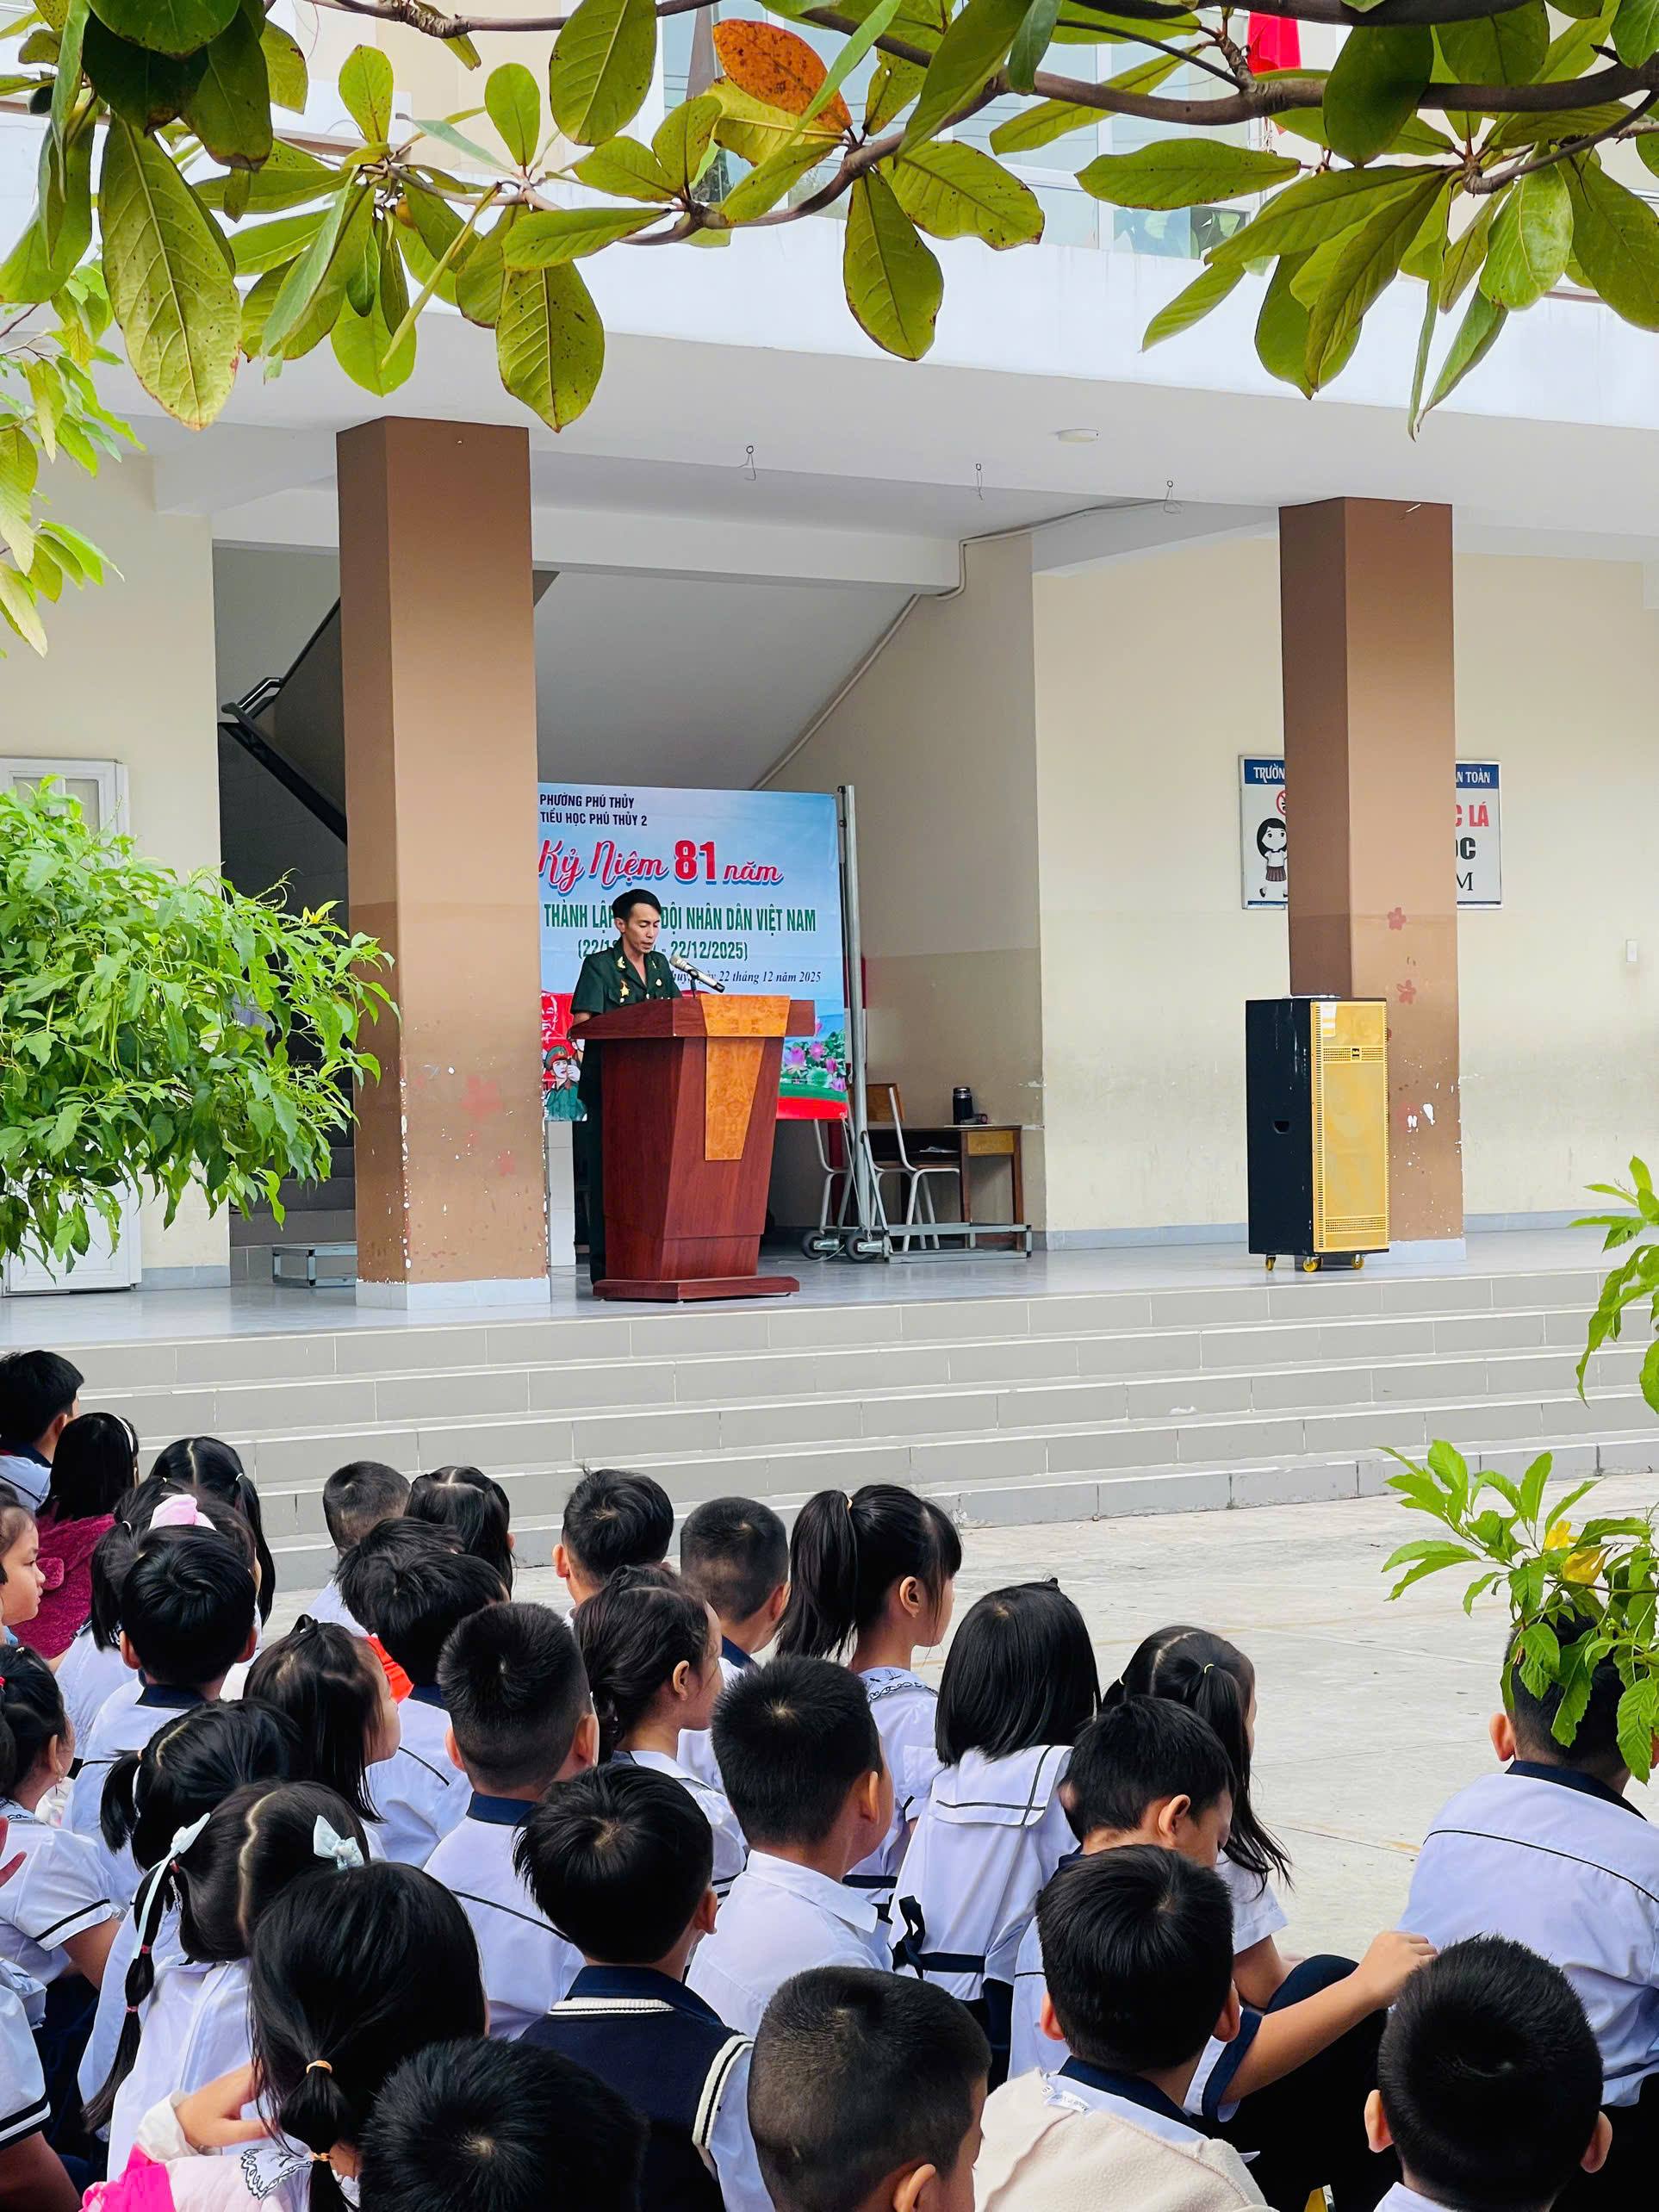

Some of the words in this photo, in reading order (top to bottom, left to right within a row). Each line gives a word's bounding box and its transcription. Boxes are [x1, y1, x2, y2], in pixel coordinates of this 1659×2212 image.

[1252, 763, 1285, 783] TRƯỜN
[1465, 767, 1490, 783] TOÀN
[539, 792, 582, 806] PHƯỜNG
[586, 794, 606, 807] PHÚ
[609, 793, 635, 809] THỦY
[540, 807, 562, 823] TIỂU
[566, 812, 586, 826] HỌC
[589, 811, 610, 824] PHÚ
[612, 811, 638, 825] THỦY
[641, 815, 648, 826] 2
[1469, 801, 1489, 827] LÁ
[538, 839, 584, 893] Kỷ
[589, 840, 668, 885] Niệm
[674, 840, 717, 884] 81
[723, 861, 784, 885] năm
[544, 899, 587, 928] THÀNH
[661, 901, 681, 935] ĐỘI
[687, 903, 722, 930] NHÂN
[726, 903, 753, 931] DÂN
[756, 904, 783, 936] VIỆT
[786, 909, 817, 931] NAM
[671, 940, 749, 961] 22/12/2025)
[719, 971, 730, 982] 22
[732, 971, 760, 985] tháng
[762, 971, 774, 982] 12
[775, 972, 797, 982] năm
[798, 972, 822, 982] 2025
